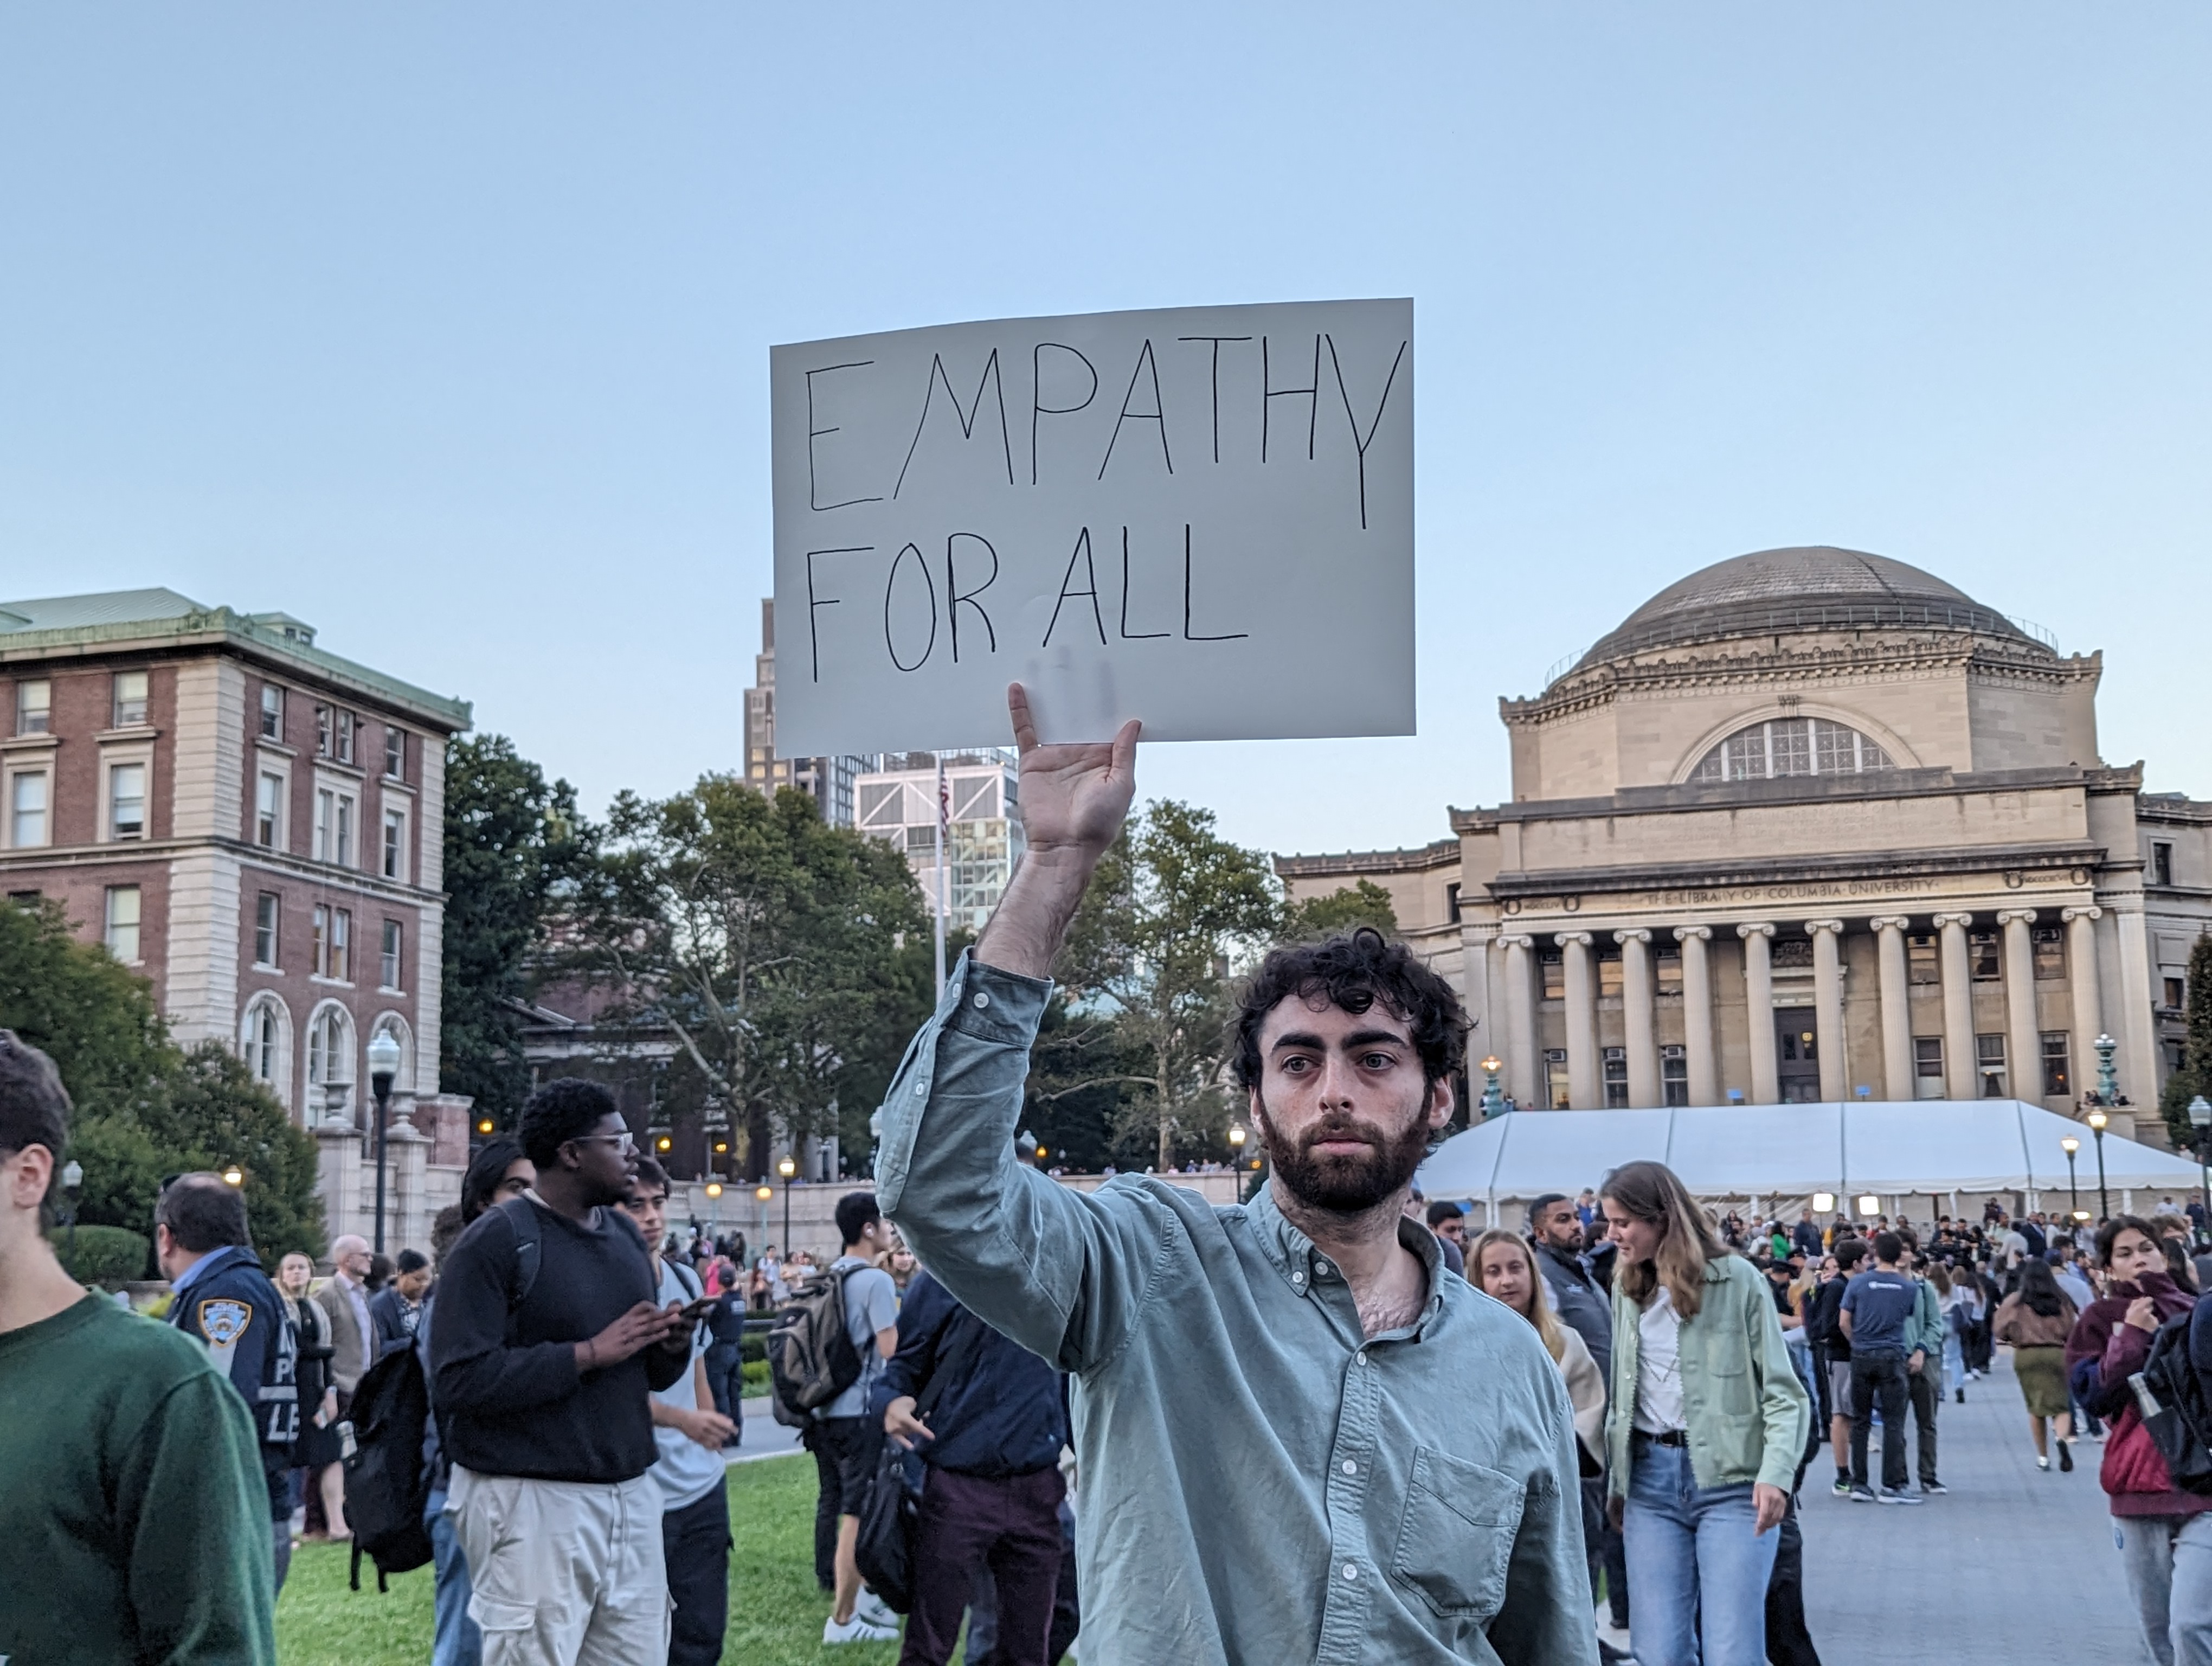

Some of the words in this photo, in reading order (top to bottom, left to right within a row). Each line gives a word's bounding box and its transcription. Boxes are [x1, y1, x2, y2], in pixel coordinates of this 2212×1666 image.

[806, 333, 1406, 529] EMPATHY
[807, 532, 998, 683] FOR
[1042, 523, 1249, 648] ALL
[1645, 894, 1672, 905] THE
[1742, 888, 1761, 900] OF
[1768, 884, 1841, 899] COLUMBIA
[1848, 879, 1934, 895] UNIVERSITY
